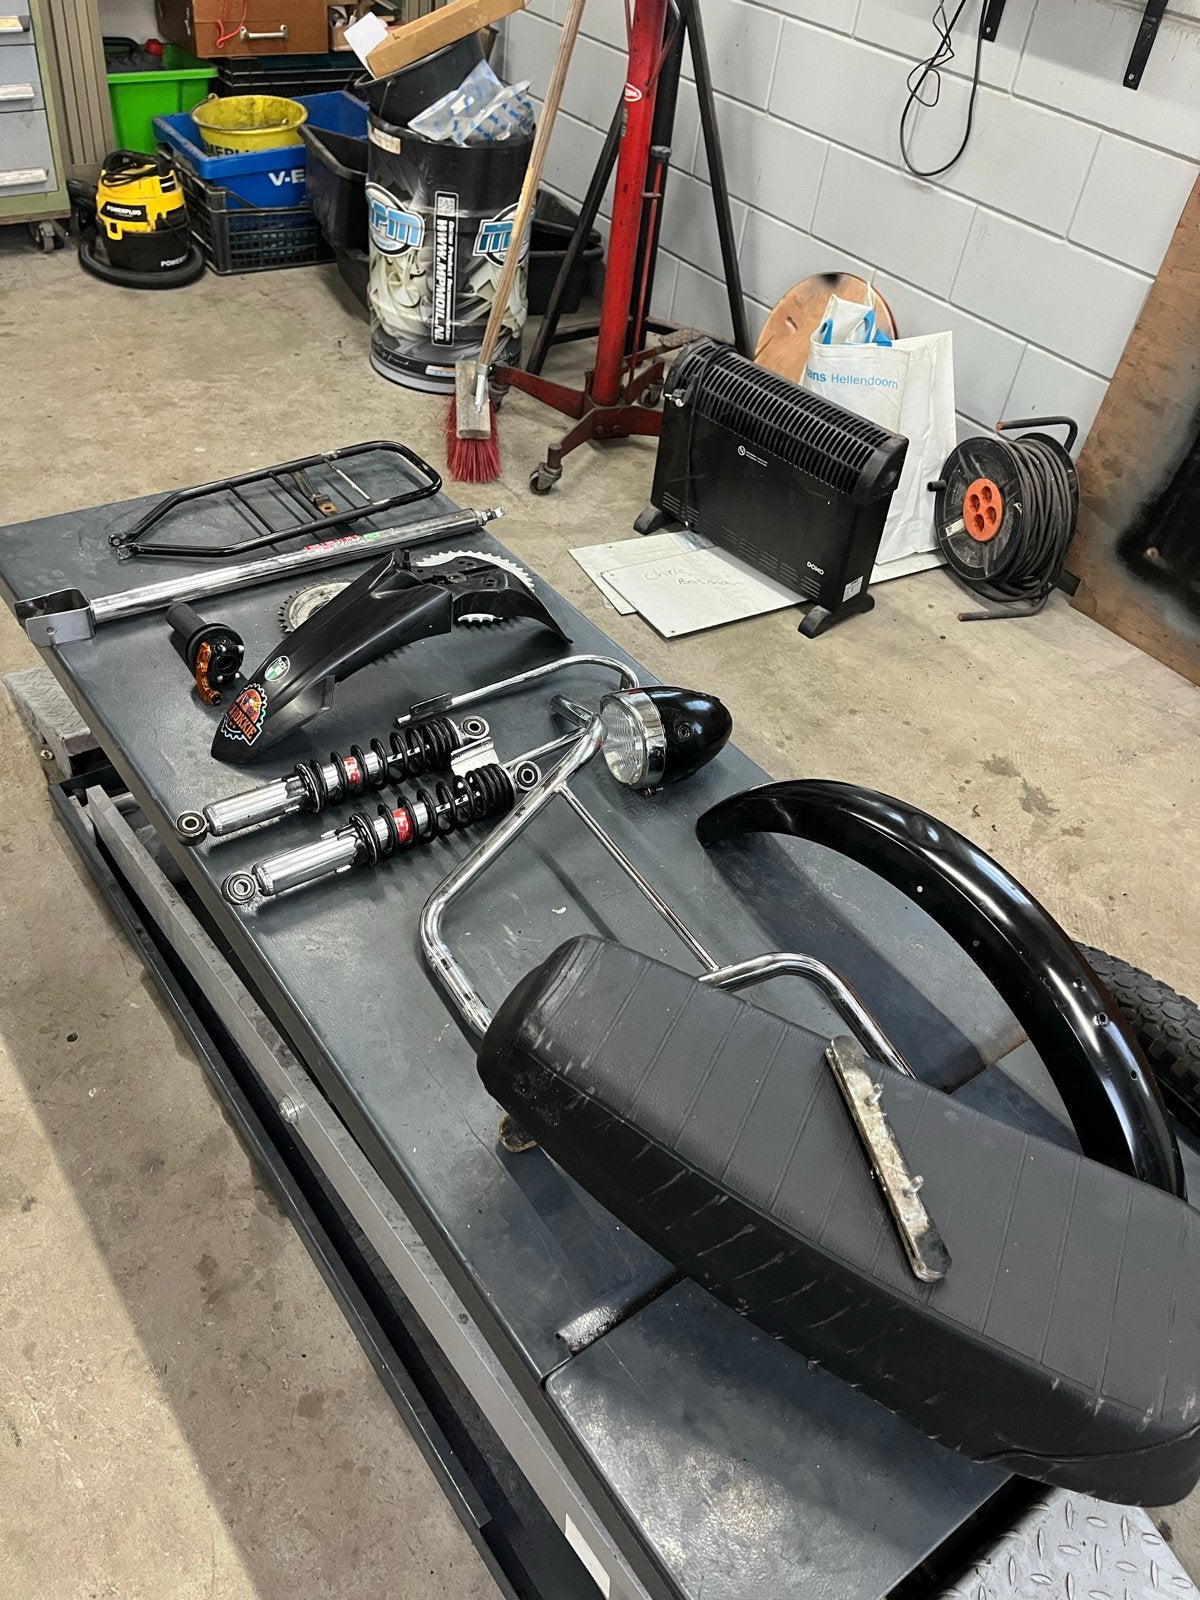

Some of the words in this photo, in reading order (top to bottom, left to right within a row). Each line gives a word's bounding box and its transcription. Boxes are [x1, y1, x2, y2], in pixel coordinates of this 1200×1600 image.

[806, 366, 827, 383] ans
[831, 373, 898, 390] Hellendoorn
[806, 561, 825, 576] DOMO
